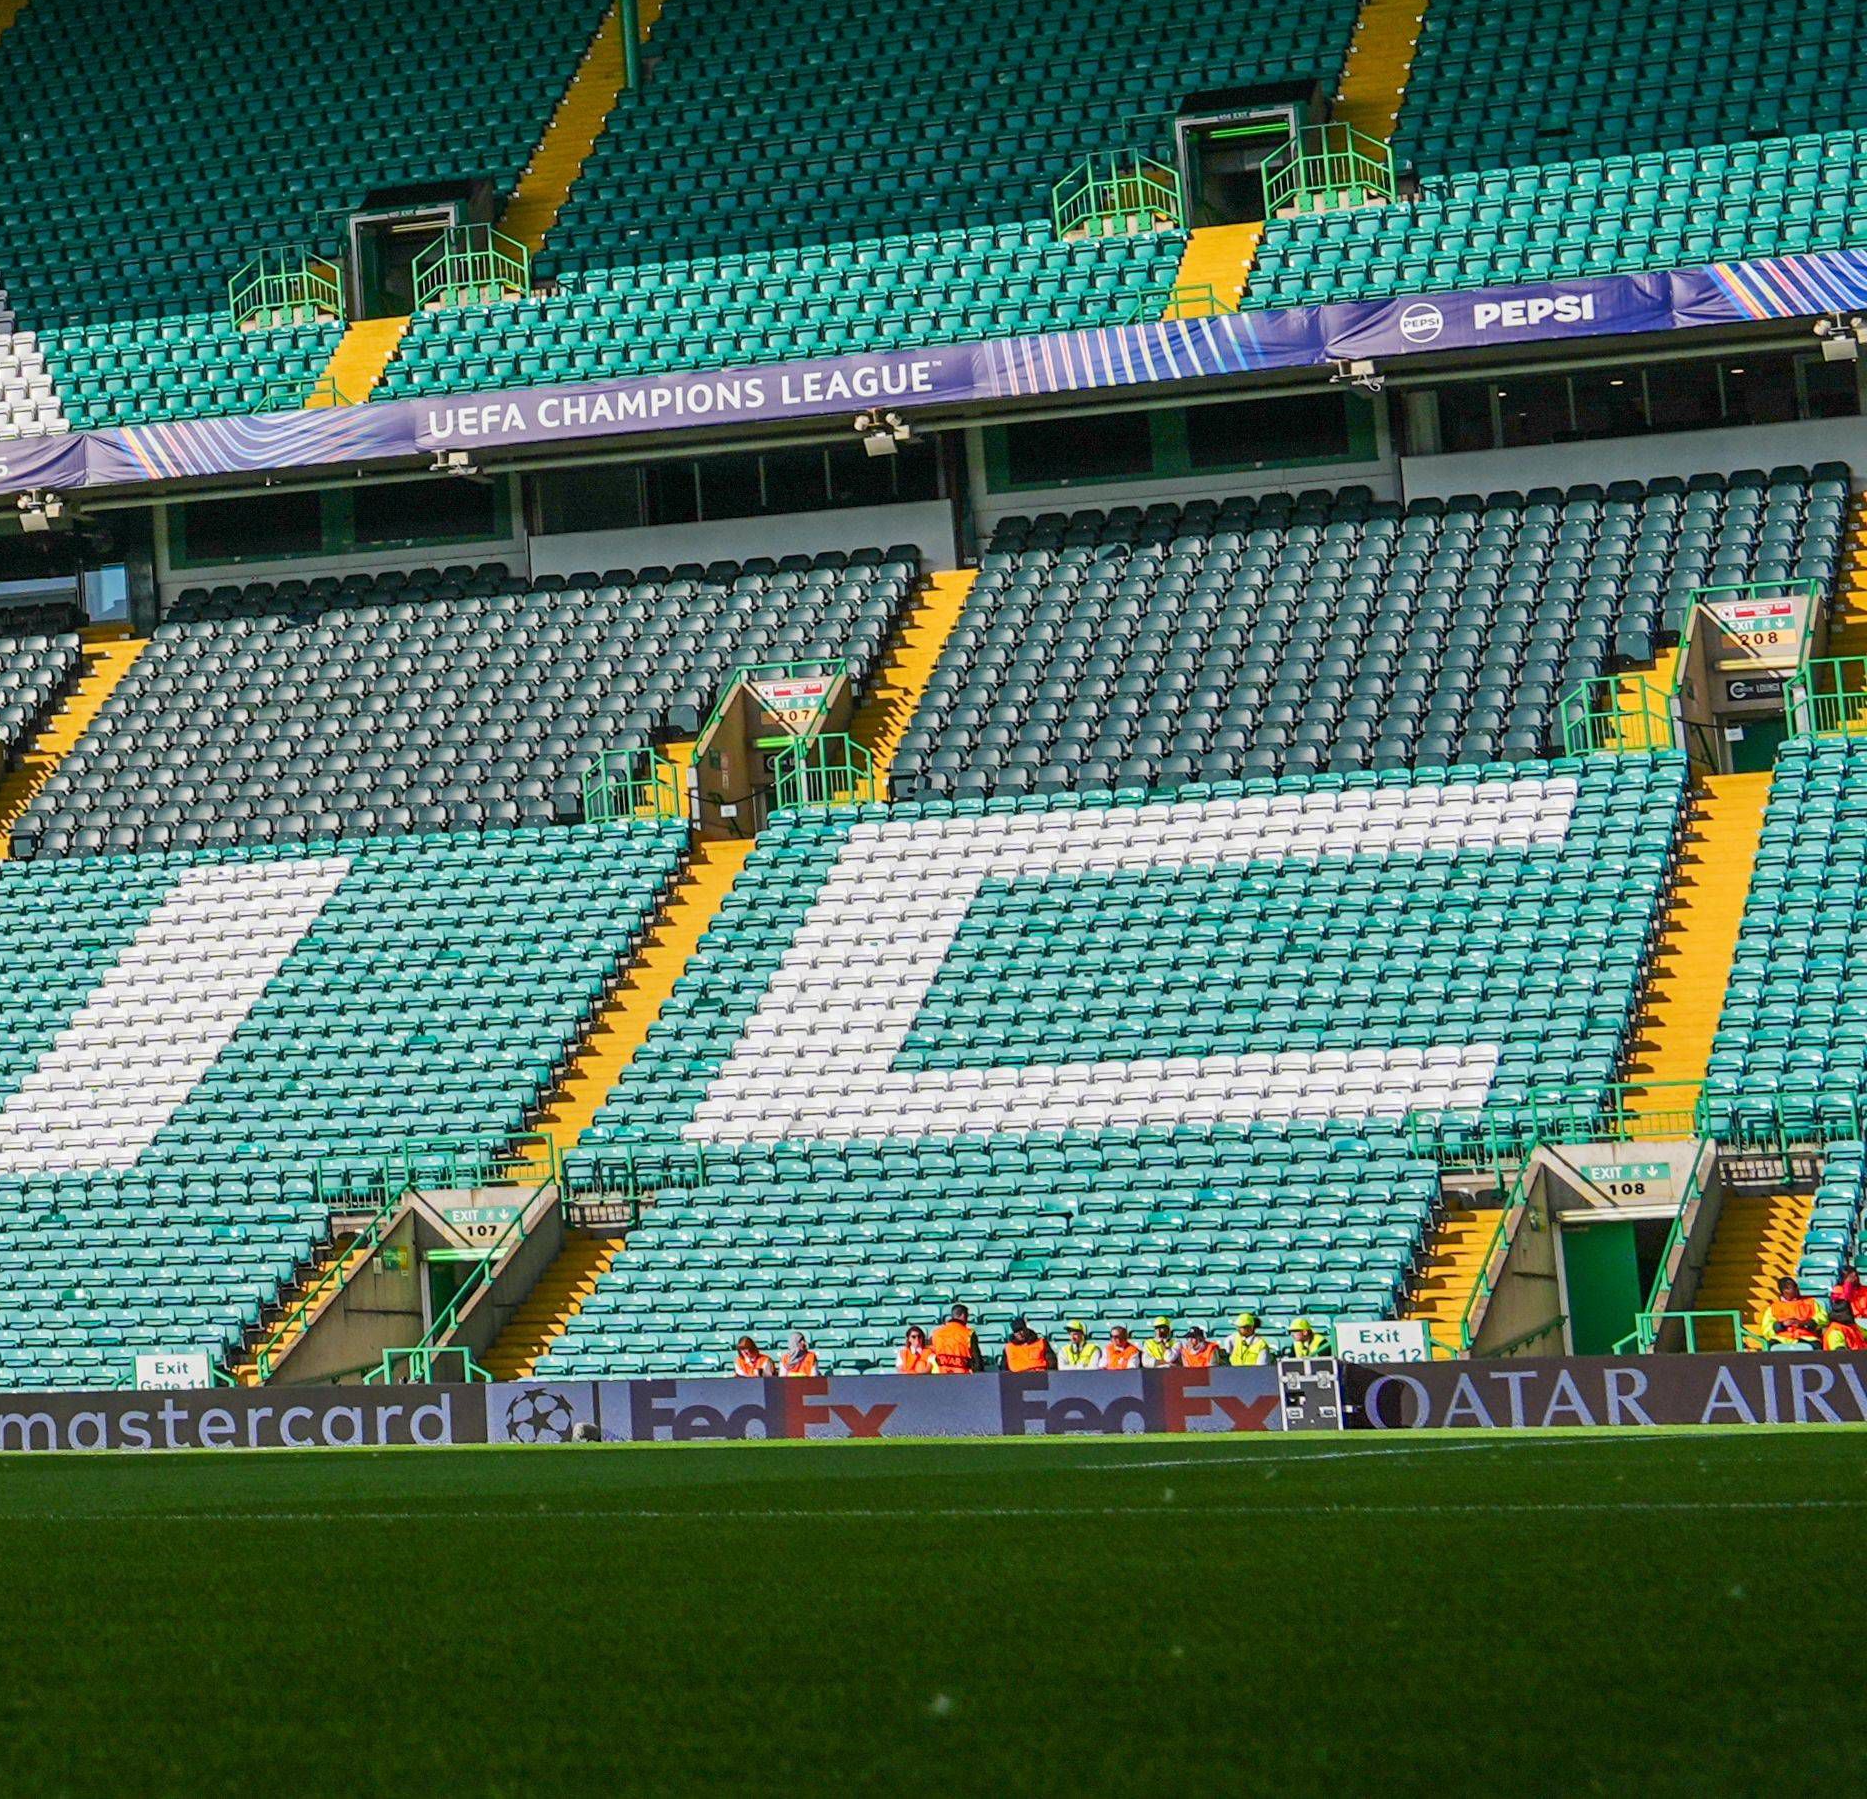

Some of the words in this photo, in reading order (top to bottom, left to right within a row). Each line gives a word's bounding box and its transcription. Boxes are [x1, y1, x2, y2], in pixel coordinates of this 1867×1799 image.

[1473, 293, 1595, 329] PEPSI
[1403, 319, 1441, 330] PEPSI
[429, 402, 527, 440] UEFA
[537, 376, 767, 429] CHAMPIONS
[780, 361, 934, 405] LEAGUE
[1739, 632, 1778, 646] 208
[1591, 1166, 1622, 1180] EXIT
[1610, 1183, 1646, 1195] 108
[452, 1209, 478, 1221] EXIT
[467, 1225, 498, 1237] 107
[1359, 1330, 1400, 1343] Exit
[1342, 1350, 1389, 1363] Gate
[1398, 1347, 1421, 1362] 12
[154, 1362, 188, 1374] Exit
[141, 1380, 179, 1390] Gate
[189, 1380, 207, 1389] 11
[999, 1368, 1279, 1434] FedEx
[1365, 1369, 1656, 1430] QATAR
[1700, 1363, 1867, 1424] AIR
[631, 1377, 898, 1439] FedEx
